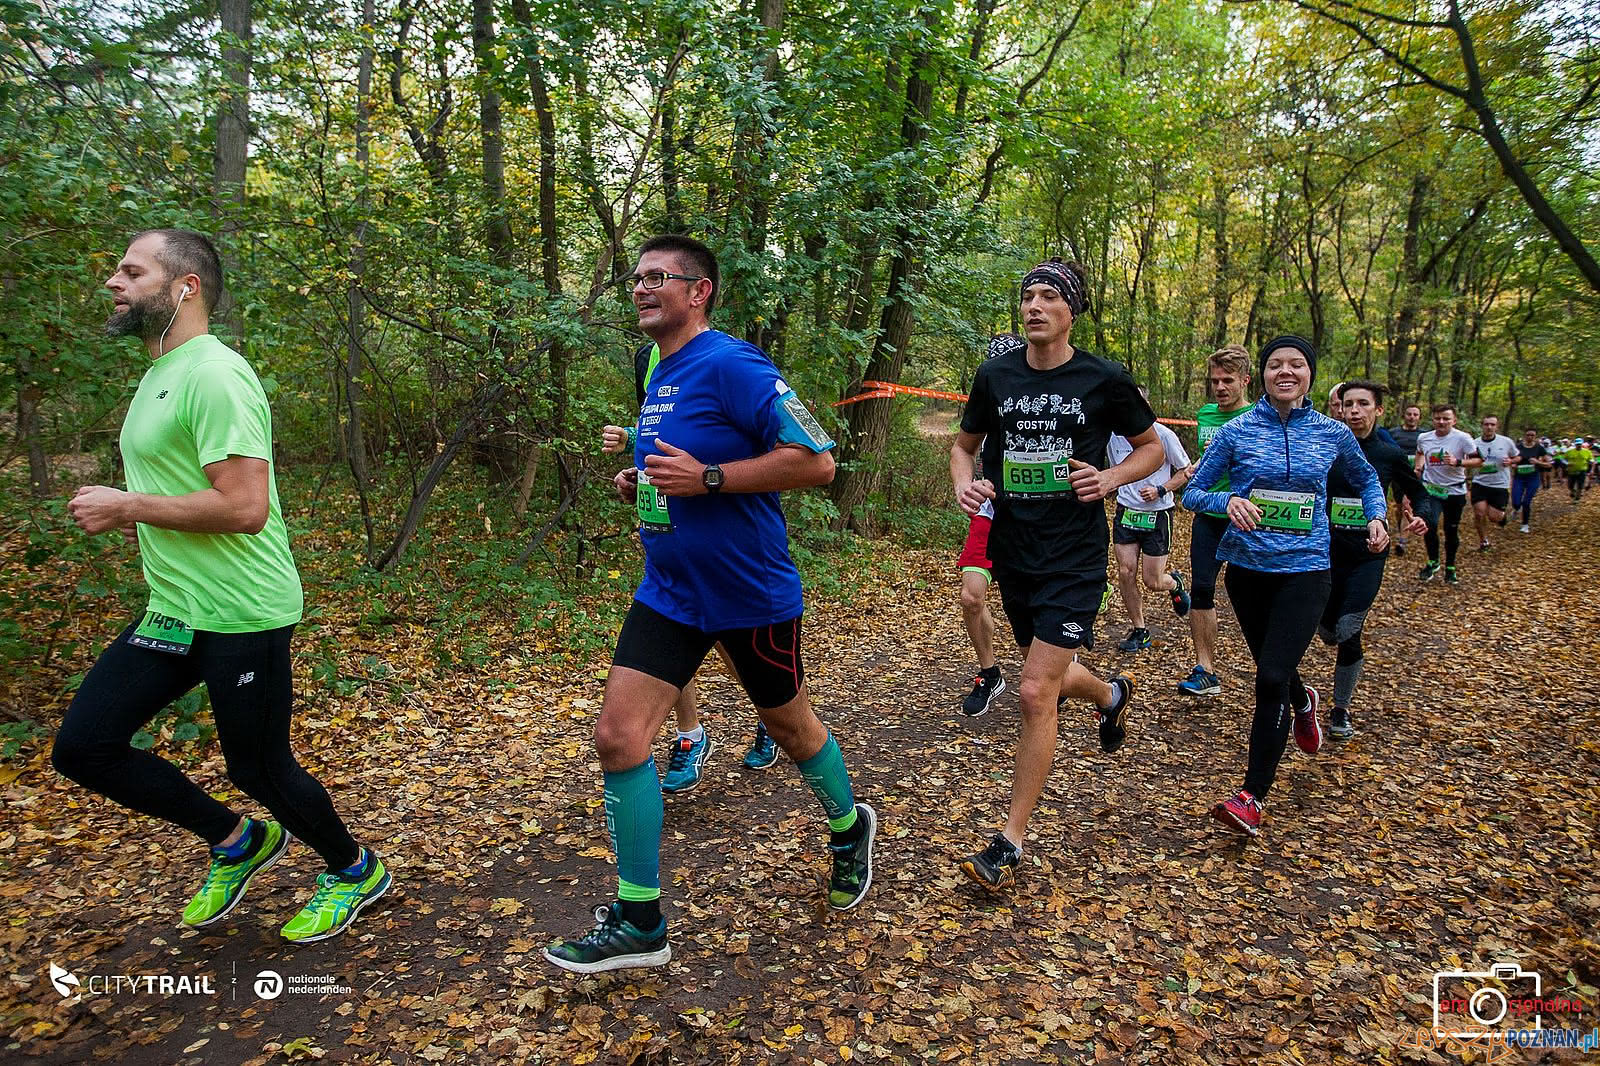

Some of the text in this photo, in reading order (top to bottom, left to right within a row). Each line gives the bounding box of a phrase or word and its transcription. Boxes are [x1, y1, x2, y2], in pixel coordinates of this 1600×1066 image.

[659, 402, 675, 413] DBK
[1016, 418, 1058, 431] GOSTYŃ
[1010, 467, 1046, 485] 683
[1337, 508, 1366, 521] 422
[1062, 630, 1080, 640] umbro
